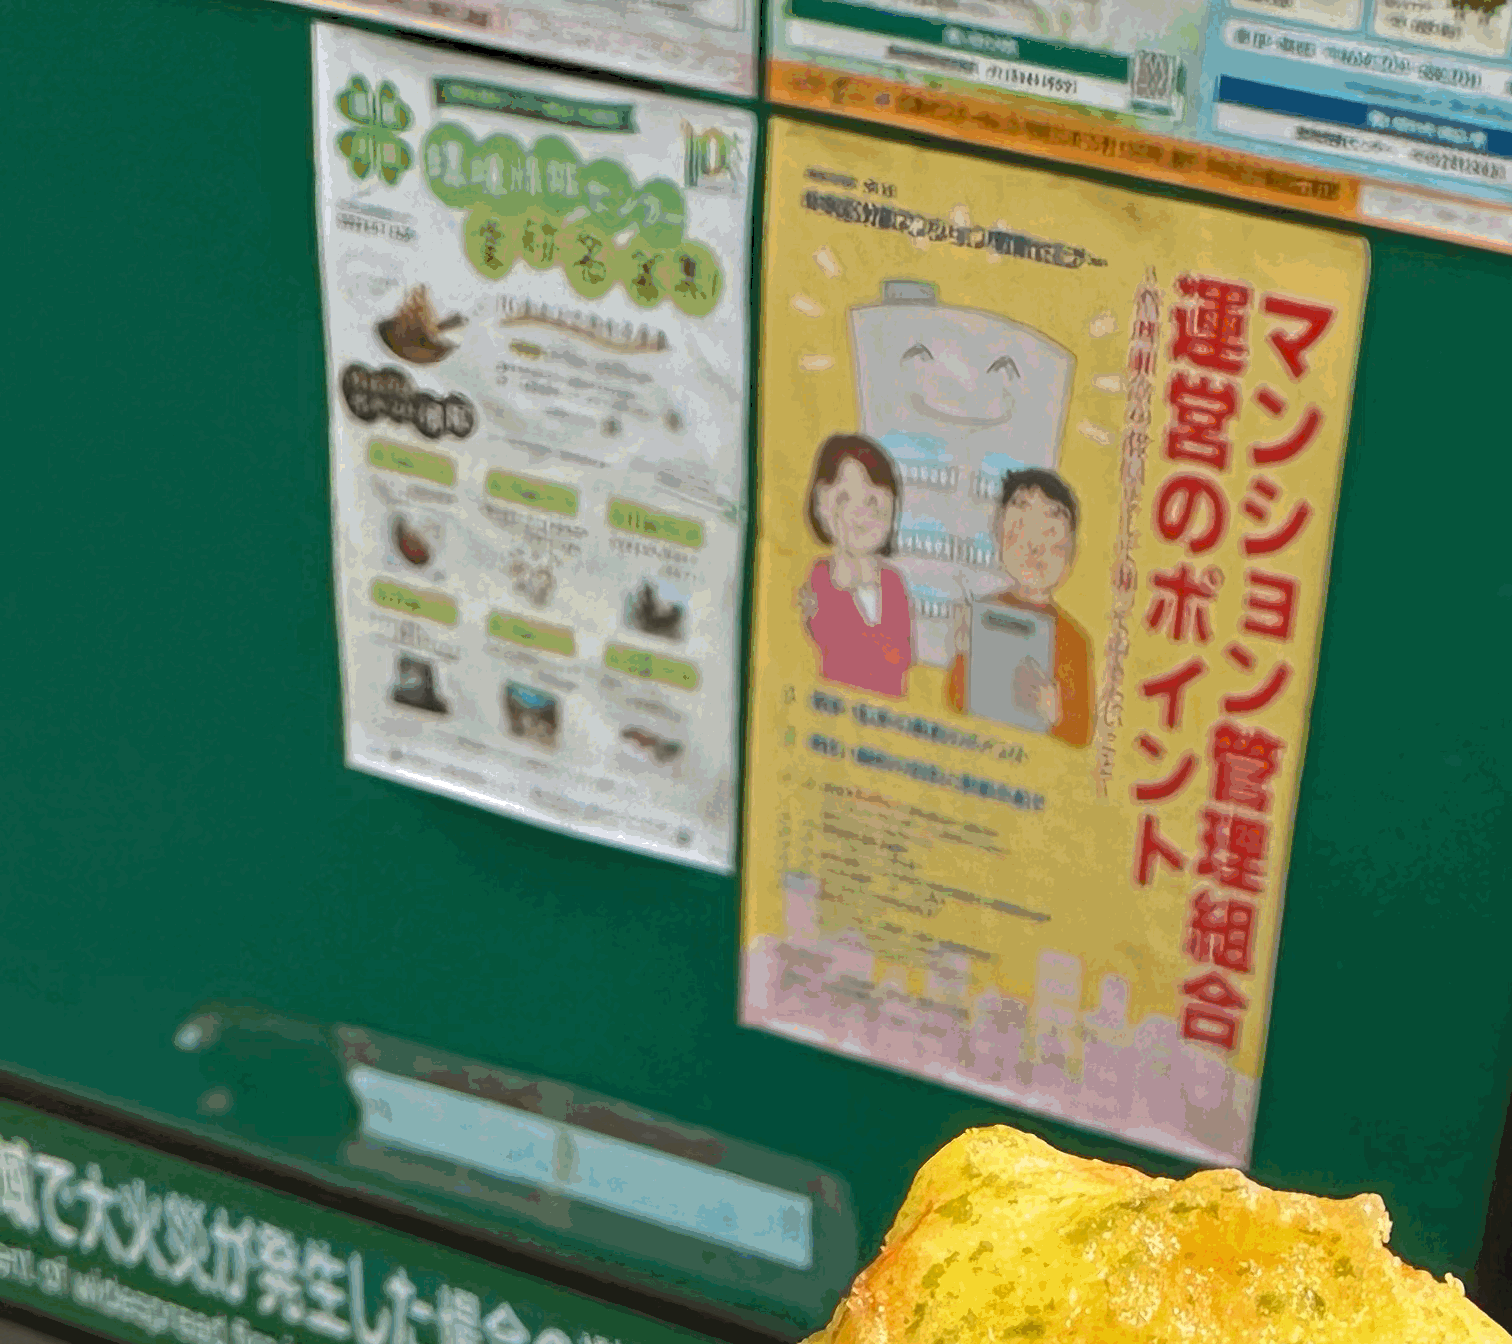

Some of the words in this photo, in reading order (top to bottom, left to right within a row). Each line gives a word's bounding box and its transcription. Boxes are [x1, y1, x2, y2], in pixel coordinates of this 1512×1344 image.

[1132, 273, 1252, 886] 運営のポイント
[1181, 294, 1335, 1050] マンション管理組合
